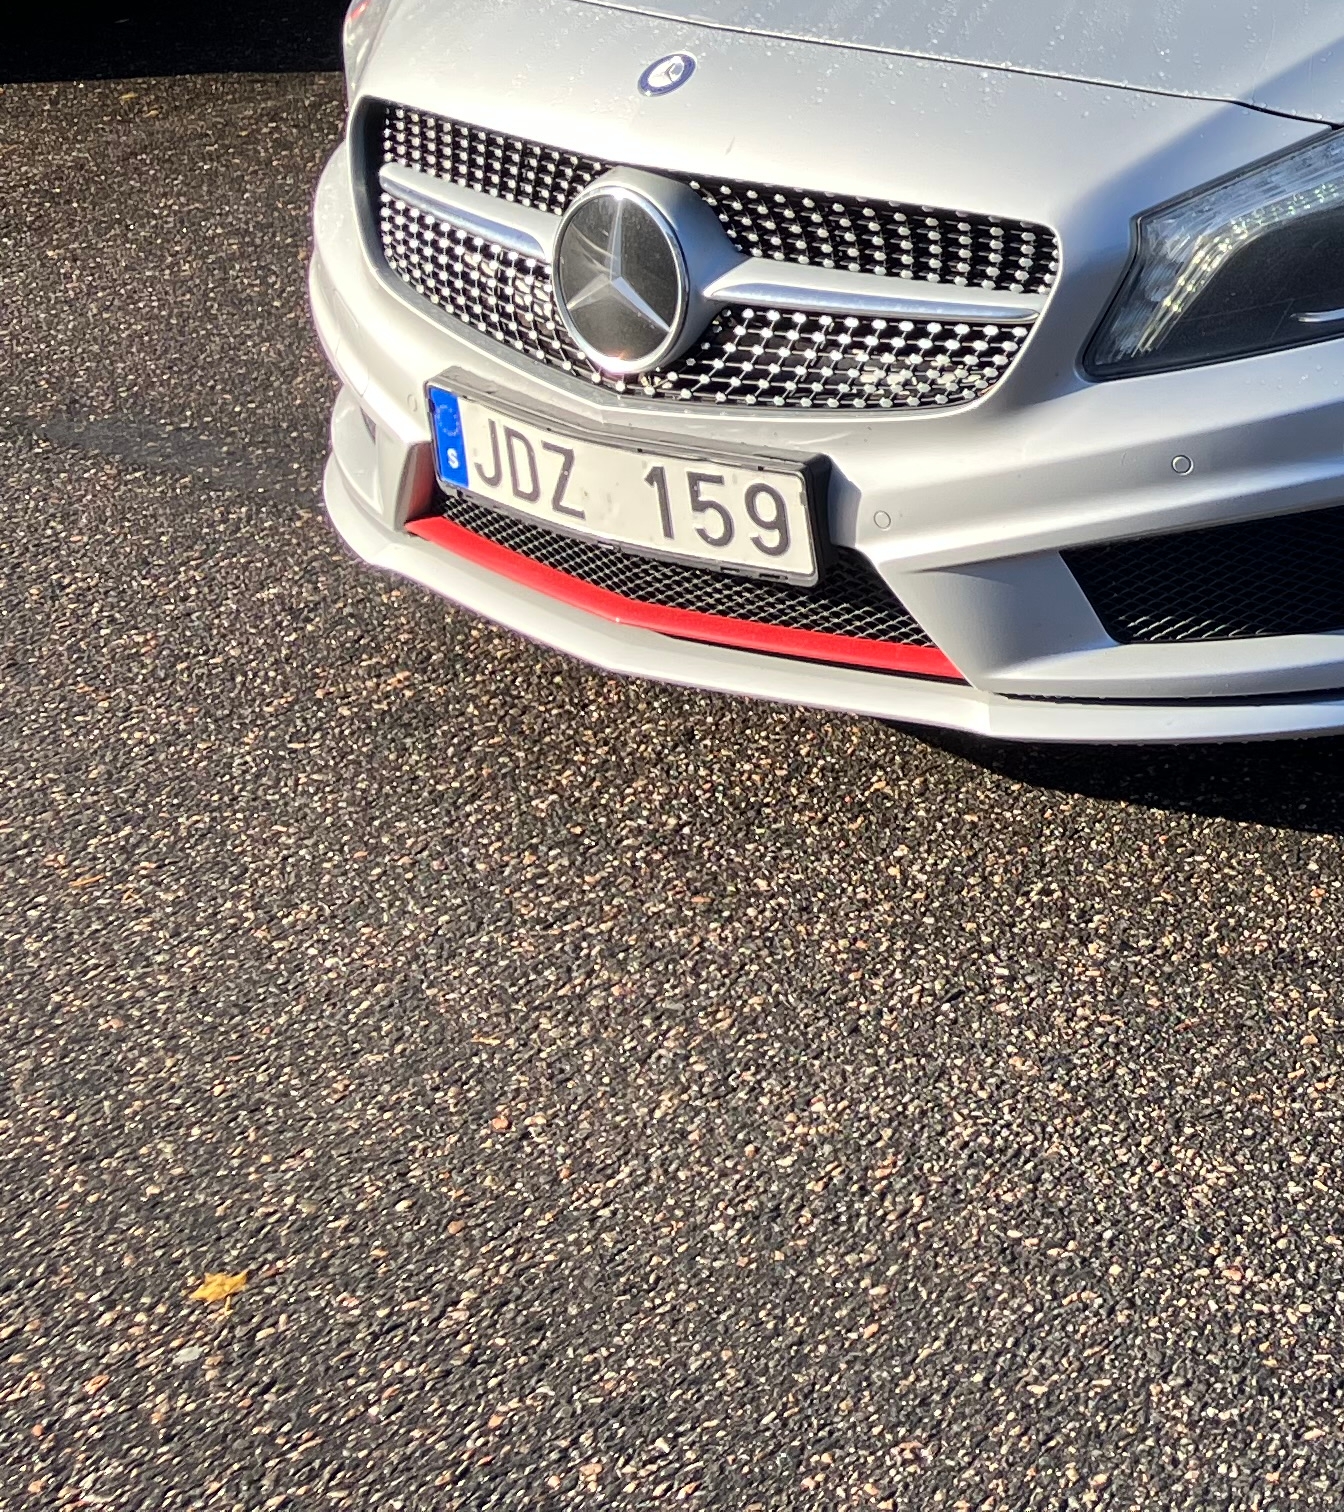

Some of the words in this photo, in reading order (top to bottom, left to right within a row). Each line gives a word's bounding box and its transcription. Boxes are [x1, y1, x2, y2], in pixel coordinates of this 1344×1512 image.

[447, 448, 459, 469] S
[473, 417, 586, 520] JDZ
[643, 465, 791, 557] 159
